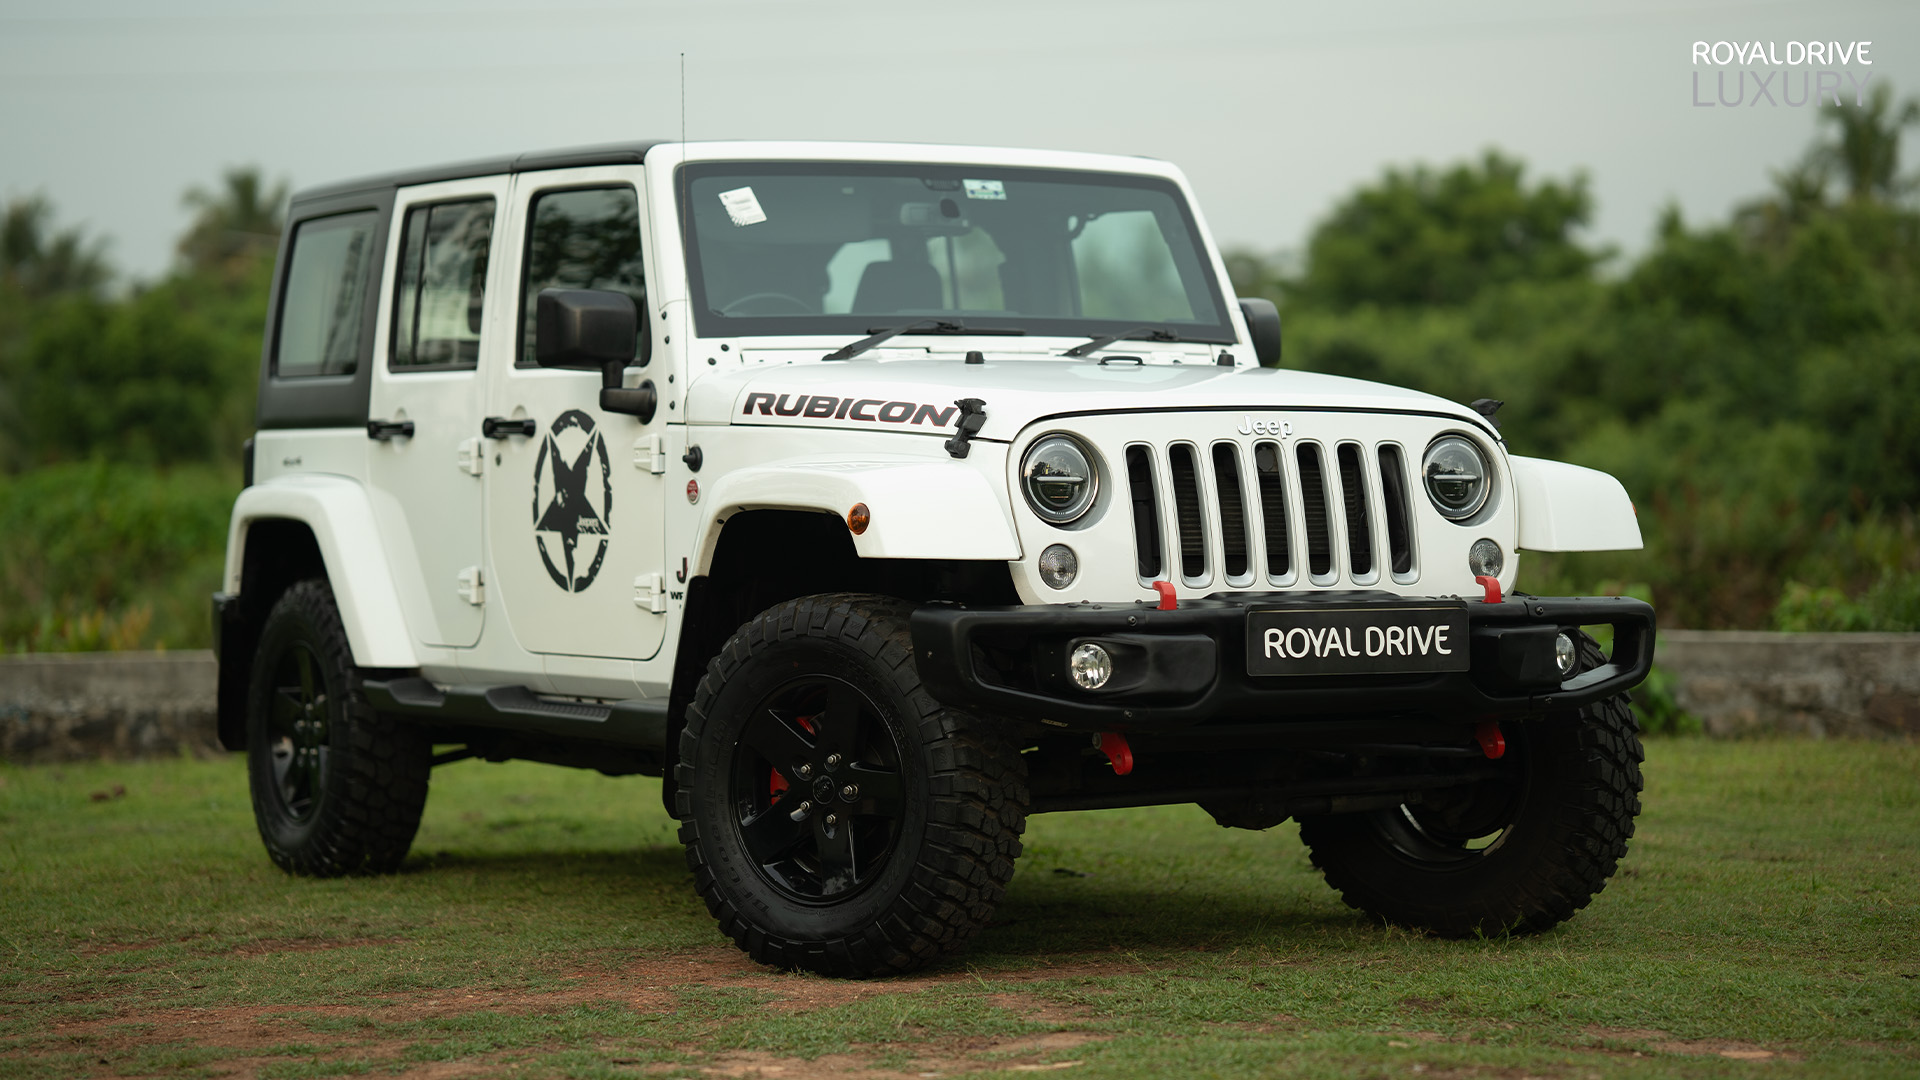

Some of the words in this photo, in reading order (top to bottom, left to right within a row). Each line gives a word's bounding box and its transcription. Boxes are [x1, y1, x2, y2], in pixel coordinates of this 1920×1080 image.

[742, 392, 959, 427] RUBICON
[1237, 415, 1293, 439] Jeep
[1264, 627, 1361, 659] ROYAL
[1365, 625, 1452, 657] DRIVE
